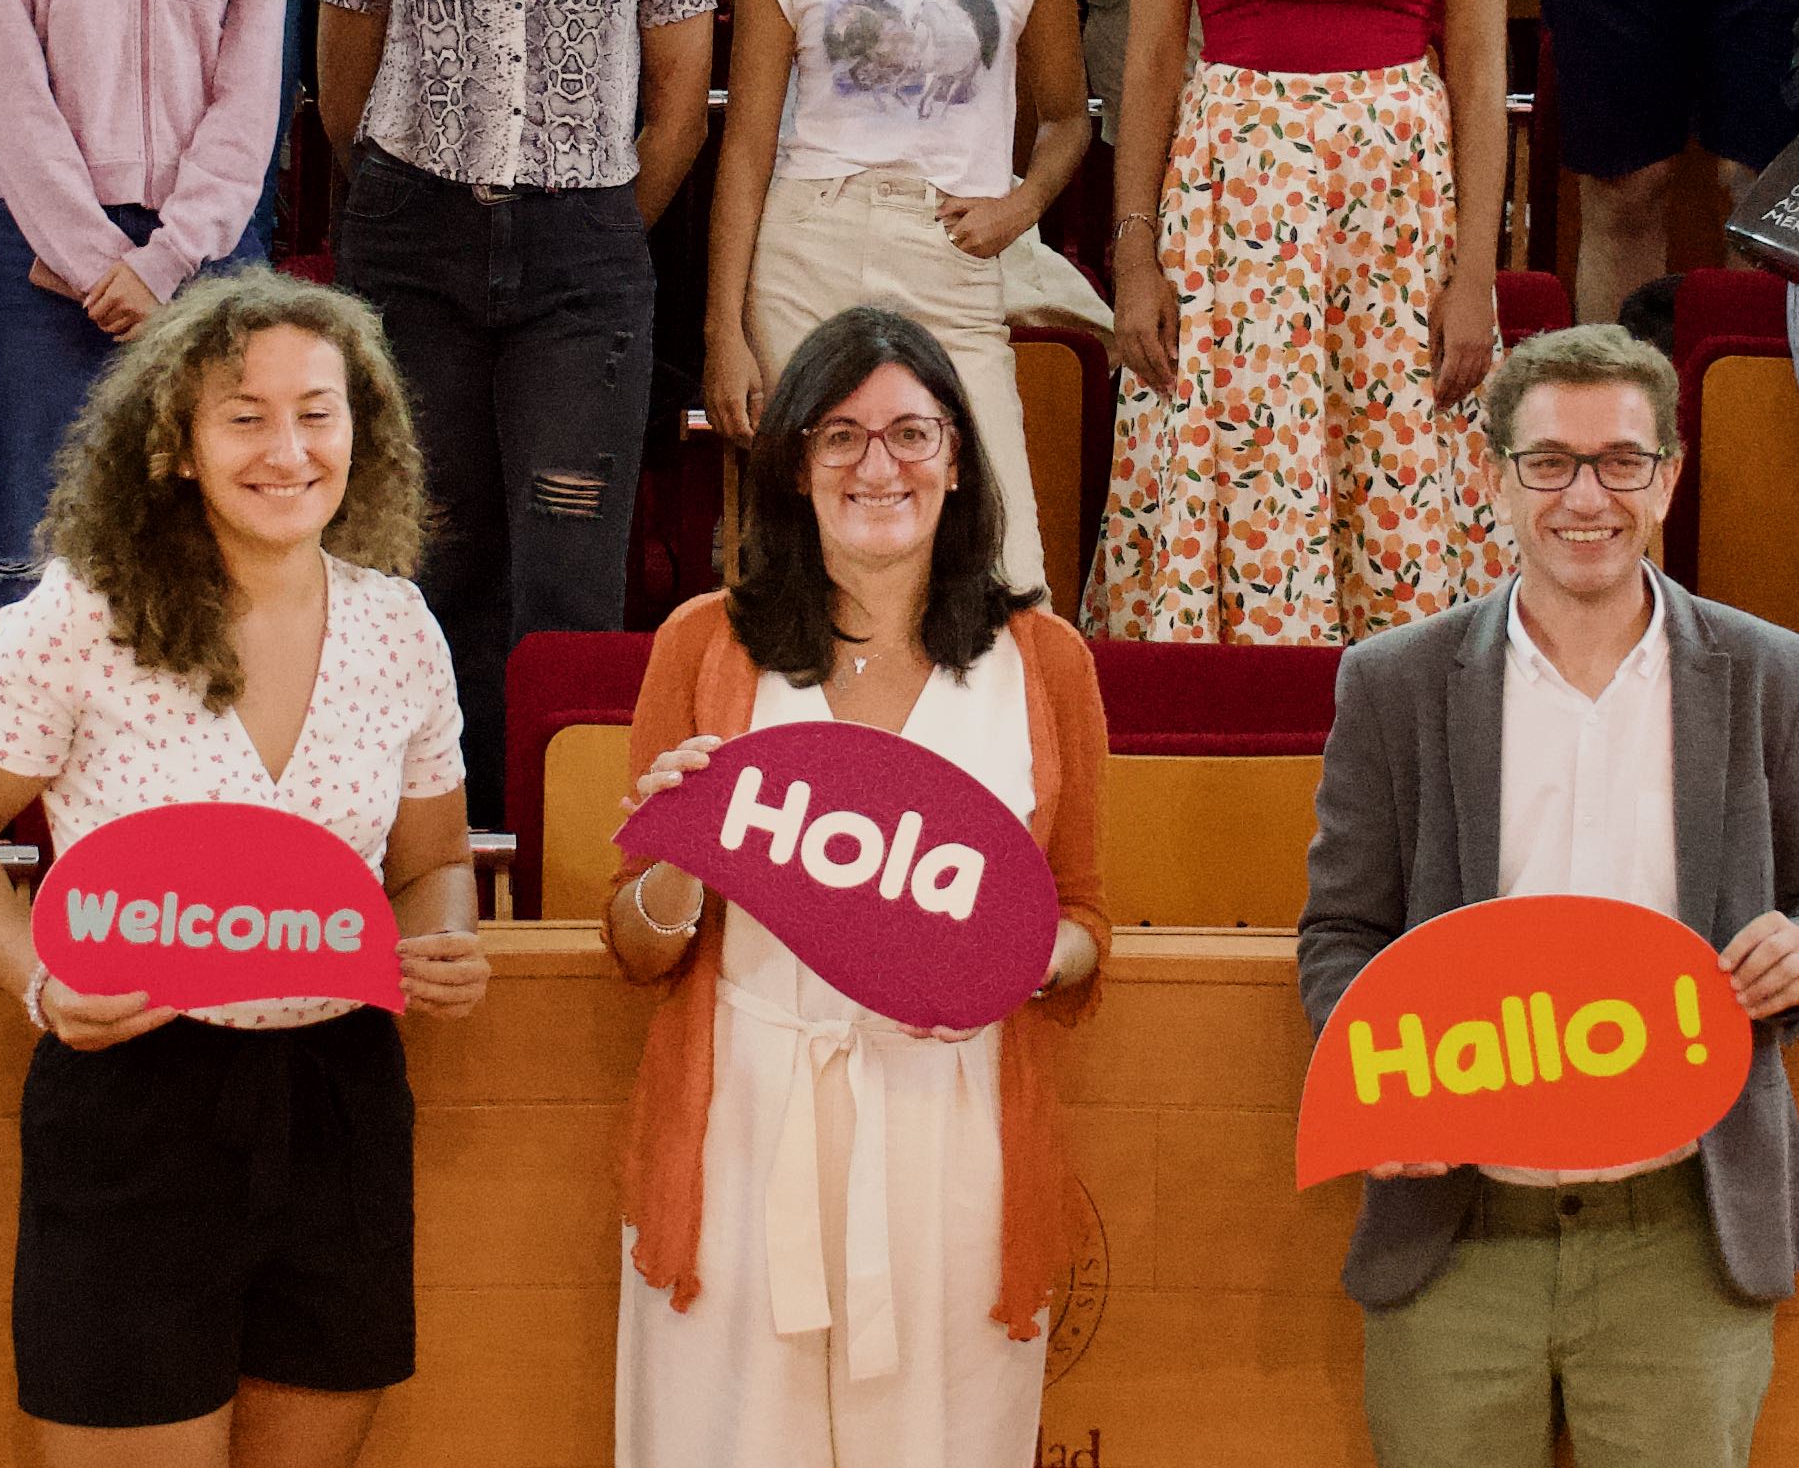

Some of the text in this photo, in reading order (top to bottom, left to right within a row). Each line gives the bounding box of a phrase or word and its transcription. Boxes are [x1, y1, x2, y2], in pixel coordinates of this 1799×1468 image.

[719, 765, 986, 921] Hola
[66, 887, 365, 952] Welcome
[1348, 991, 1648, 1106] Hallo
